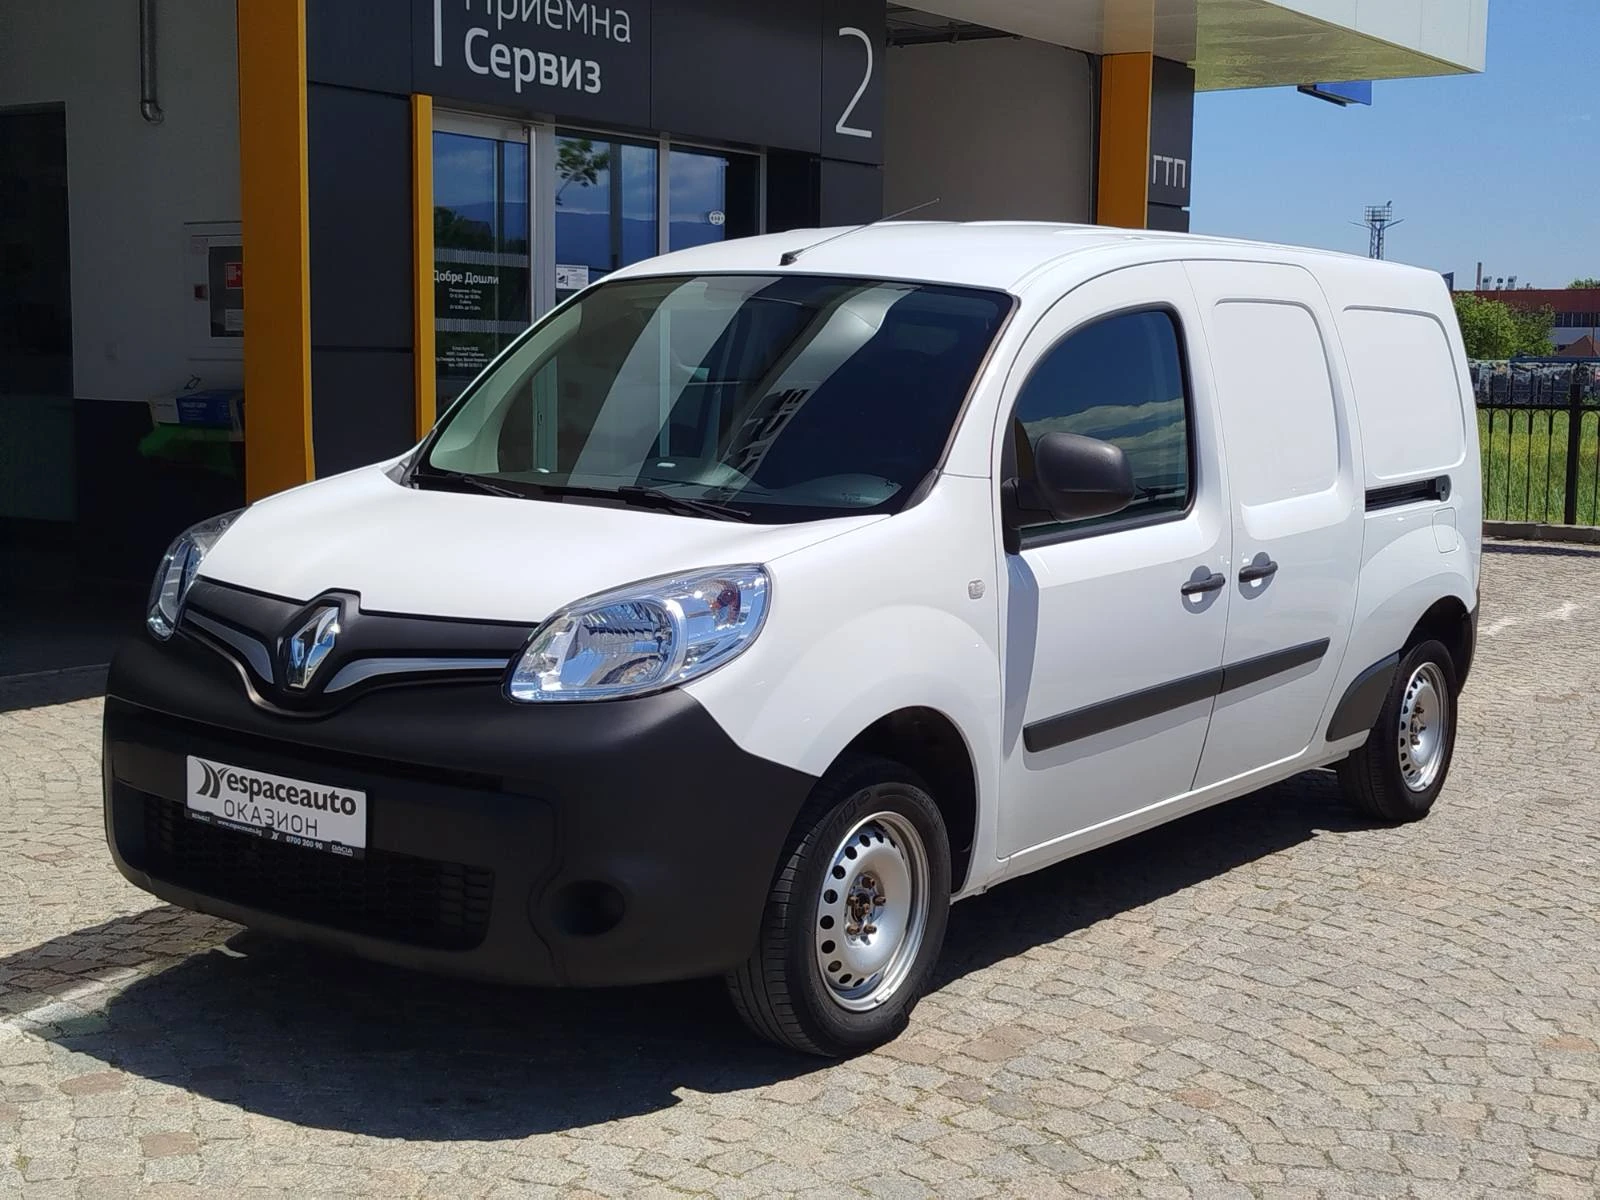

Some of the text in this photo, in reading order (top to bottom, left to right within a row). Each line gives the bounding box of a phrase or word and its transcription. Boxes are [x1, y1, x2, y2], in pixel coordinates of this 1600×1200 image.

[464, 27, 602, 93] Сервиз
[835, 27, 873, 139] 2
[1152, 154, 1187, 189] ГТП
[464, 271, 499, 285] Дошли
[226, 772, 357, 816] espaceauto
[224, 799, 319, 838] ОКАЗИОН
